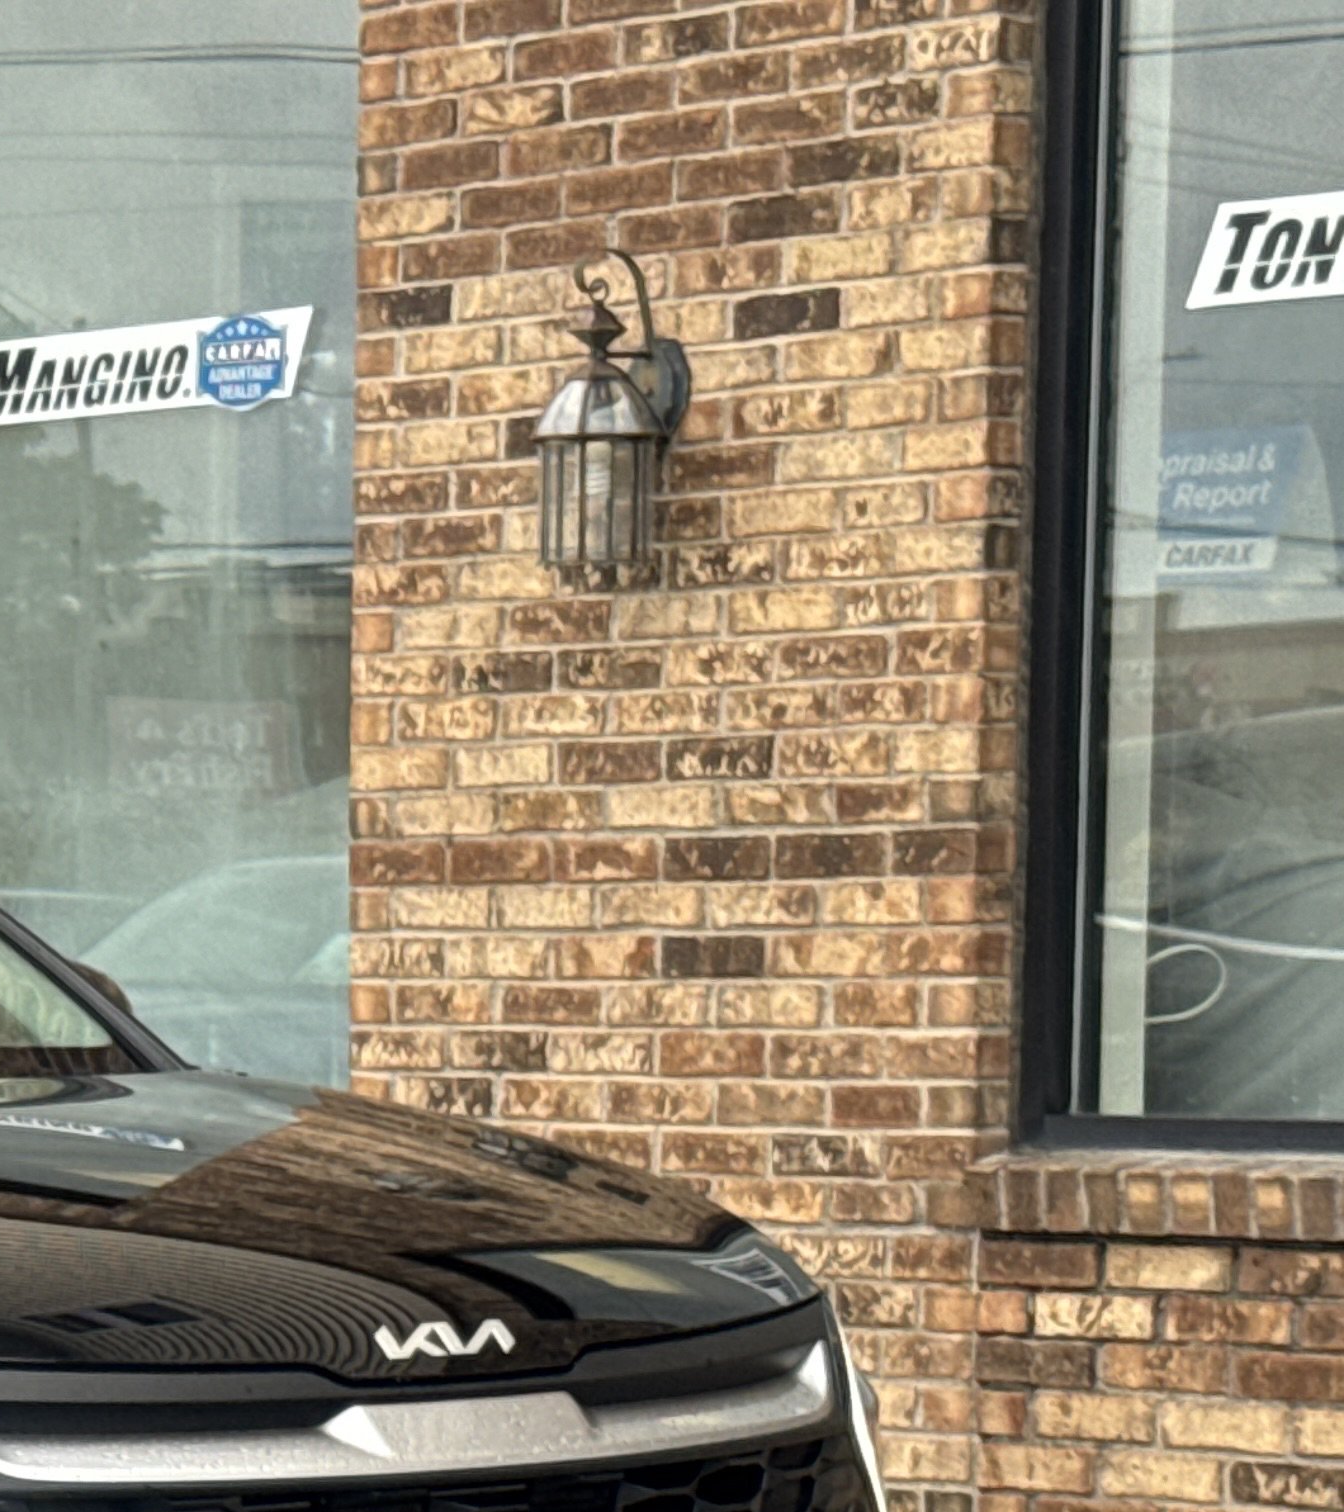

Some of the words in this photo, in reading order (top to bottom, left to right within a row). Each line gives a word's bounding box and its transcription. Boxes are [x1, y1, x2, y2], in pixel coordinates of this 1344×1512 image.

[1173, 479, 1272, 514] Report
[1166, 543, 1256, 568] CARFAX
[374, 1318, 516, 1360] KIA
